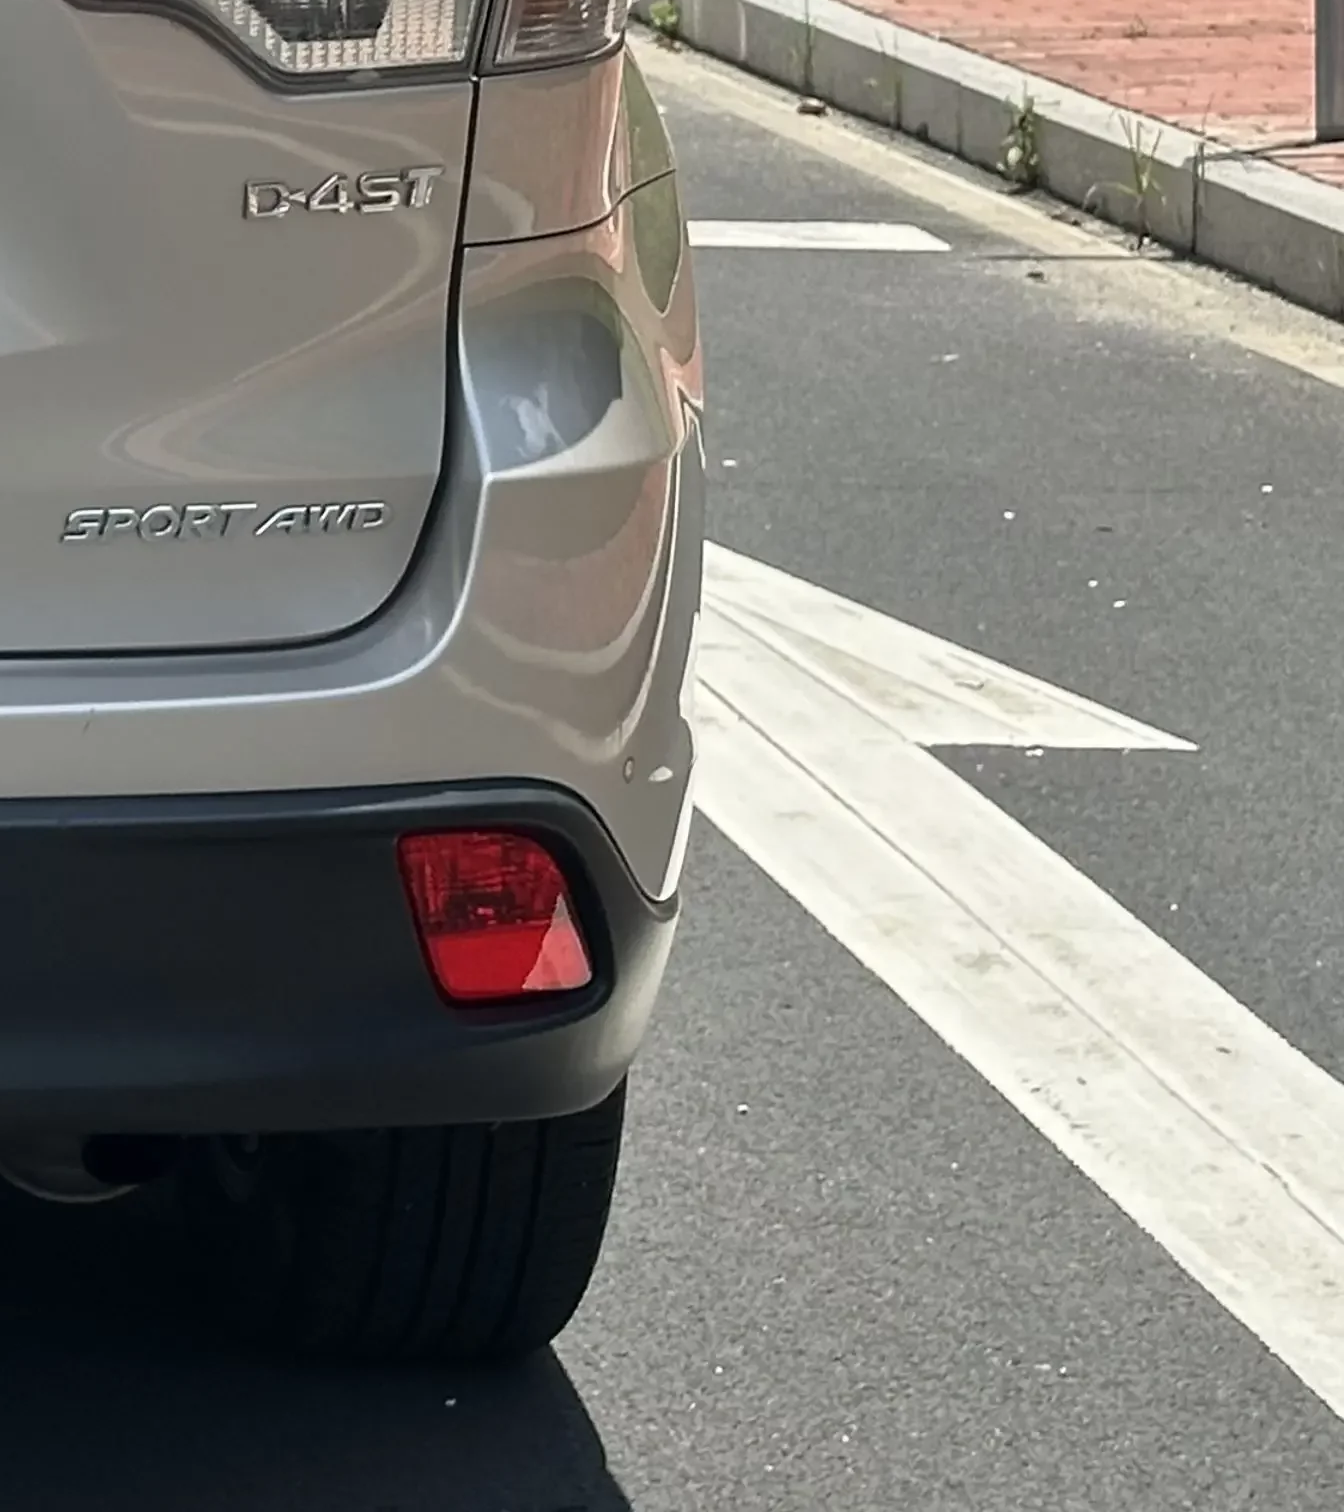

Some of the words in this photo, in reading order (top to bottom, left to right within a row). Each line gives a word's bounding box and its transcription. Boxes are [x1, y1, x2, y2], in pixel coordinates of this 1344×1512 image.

[244, 164, 444, 219] D-4ST
[61, 502, 258, 542] SPORT
[254, 501, 390, 538] AWD
